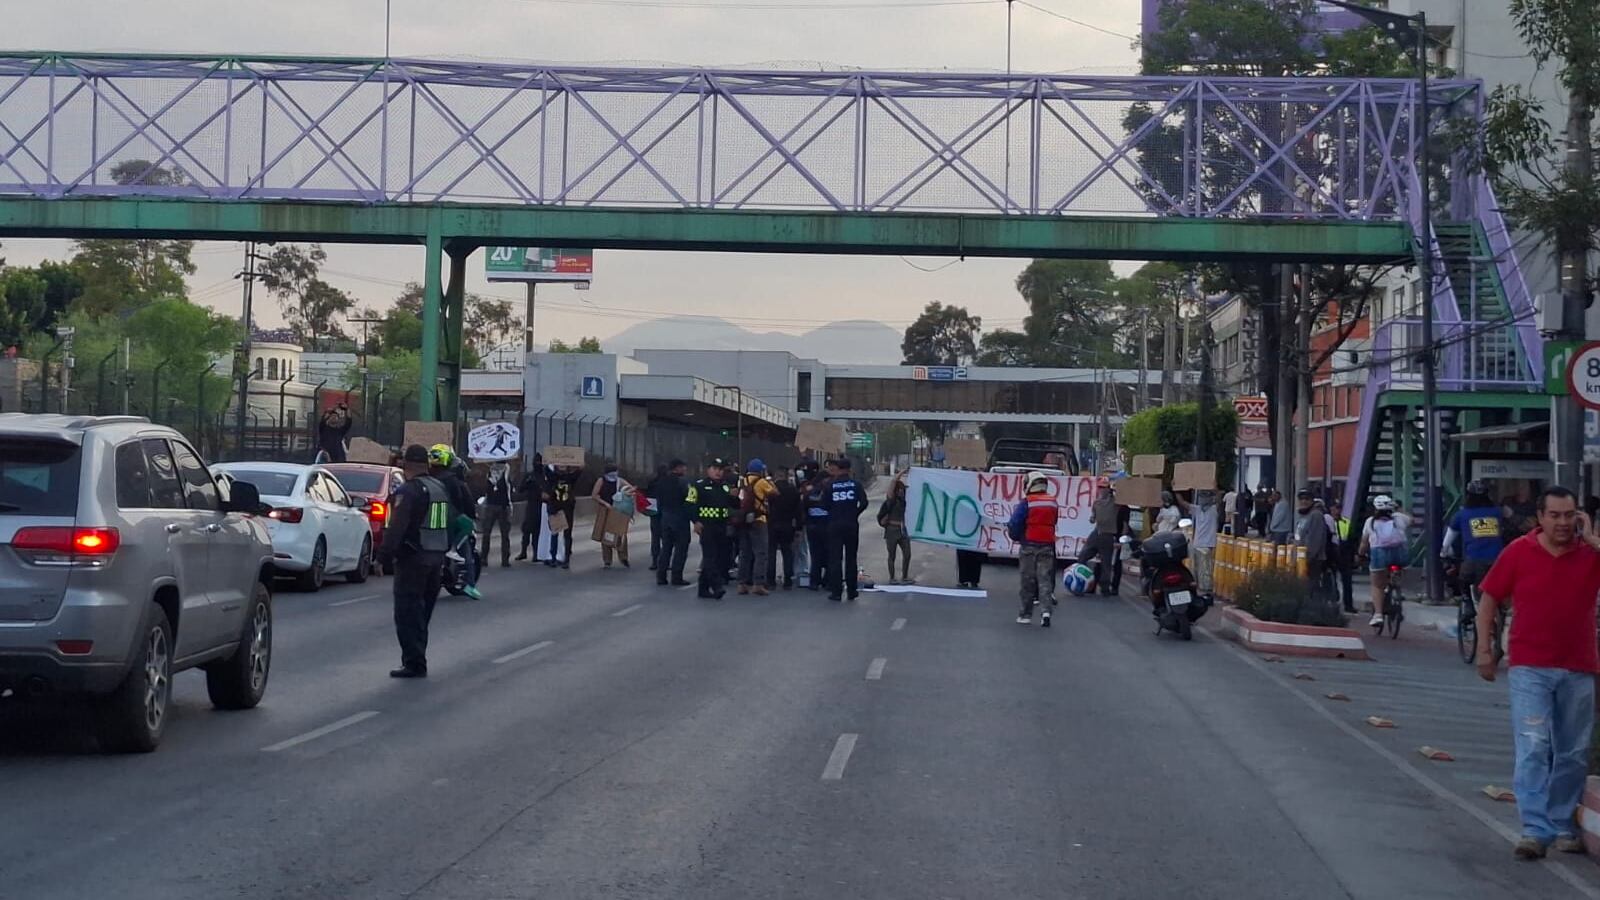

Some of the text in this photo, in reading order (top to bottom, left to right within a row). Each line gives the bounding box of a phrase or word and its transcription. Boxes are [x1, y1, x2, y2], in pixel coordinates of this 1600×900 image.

[956, 368, 967, 379] 2
[1235, 402, 1267, 417] OXX
[832, 490, 855, 501] SSC
[915, 482, 982, 538] NO
